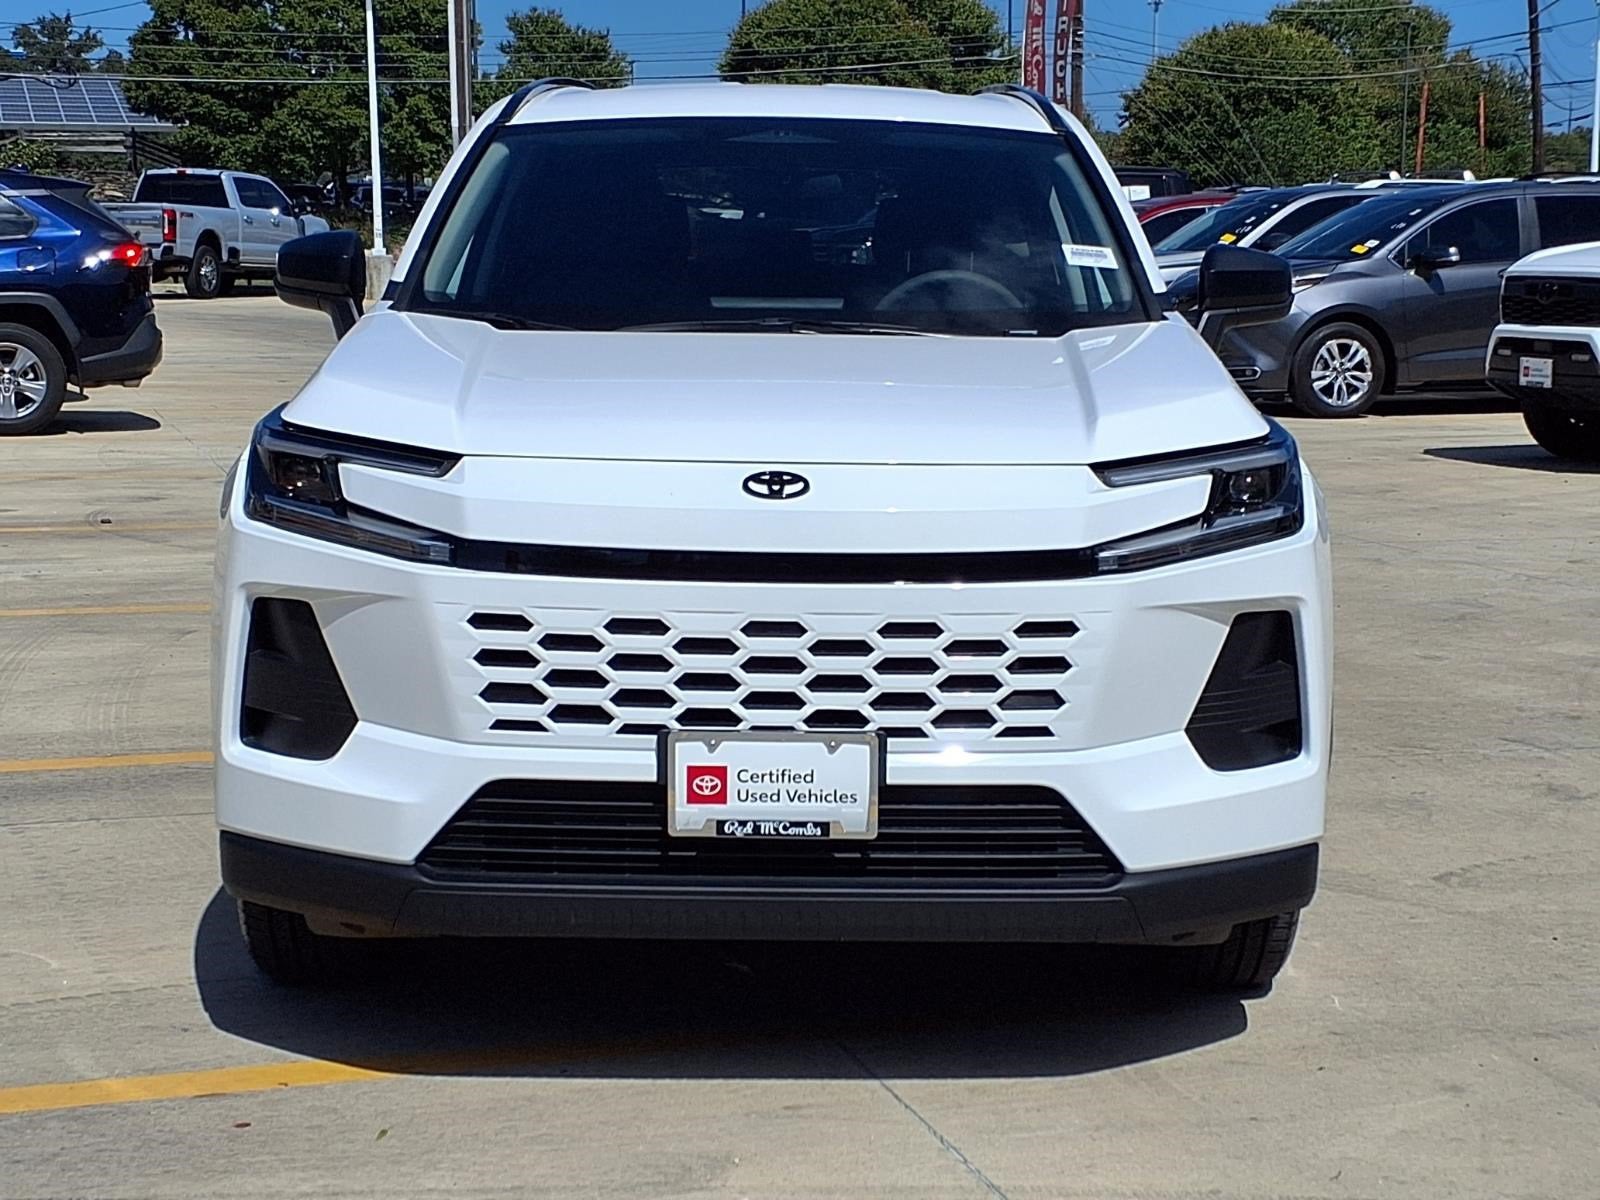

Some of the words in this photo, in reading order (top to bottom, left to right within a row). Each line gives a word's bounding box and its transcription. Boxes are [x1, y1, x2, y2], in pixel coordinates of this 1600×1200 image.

[737, 768, 814, 784] Certified
[737, 788, 780, 803] Used
[785, 788, 858, 804] Vehicles
[723, 820, 754, 837] Red
[756, 821, 822, 836] McCombs
